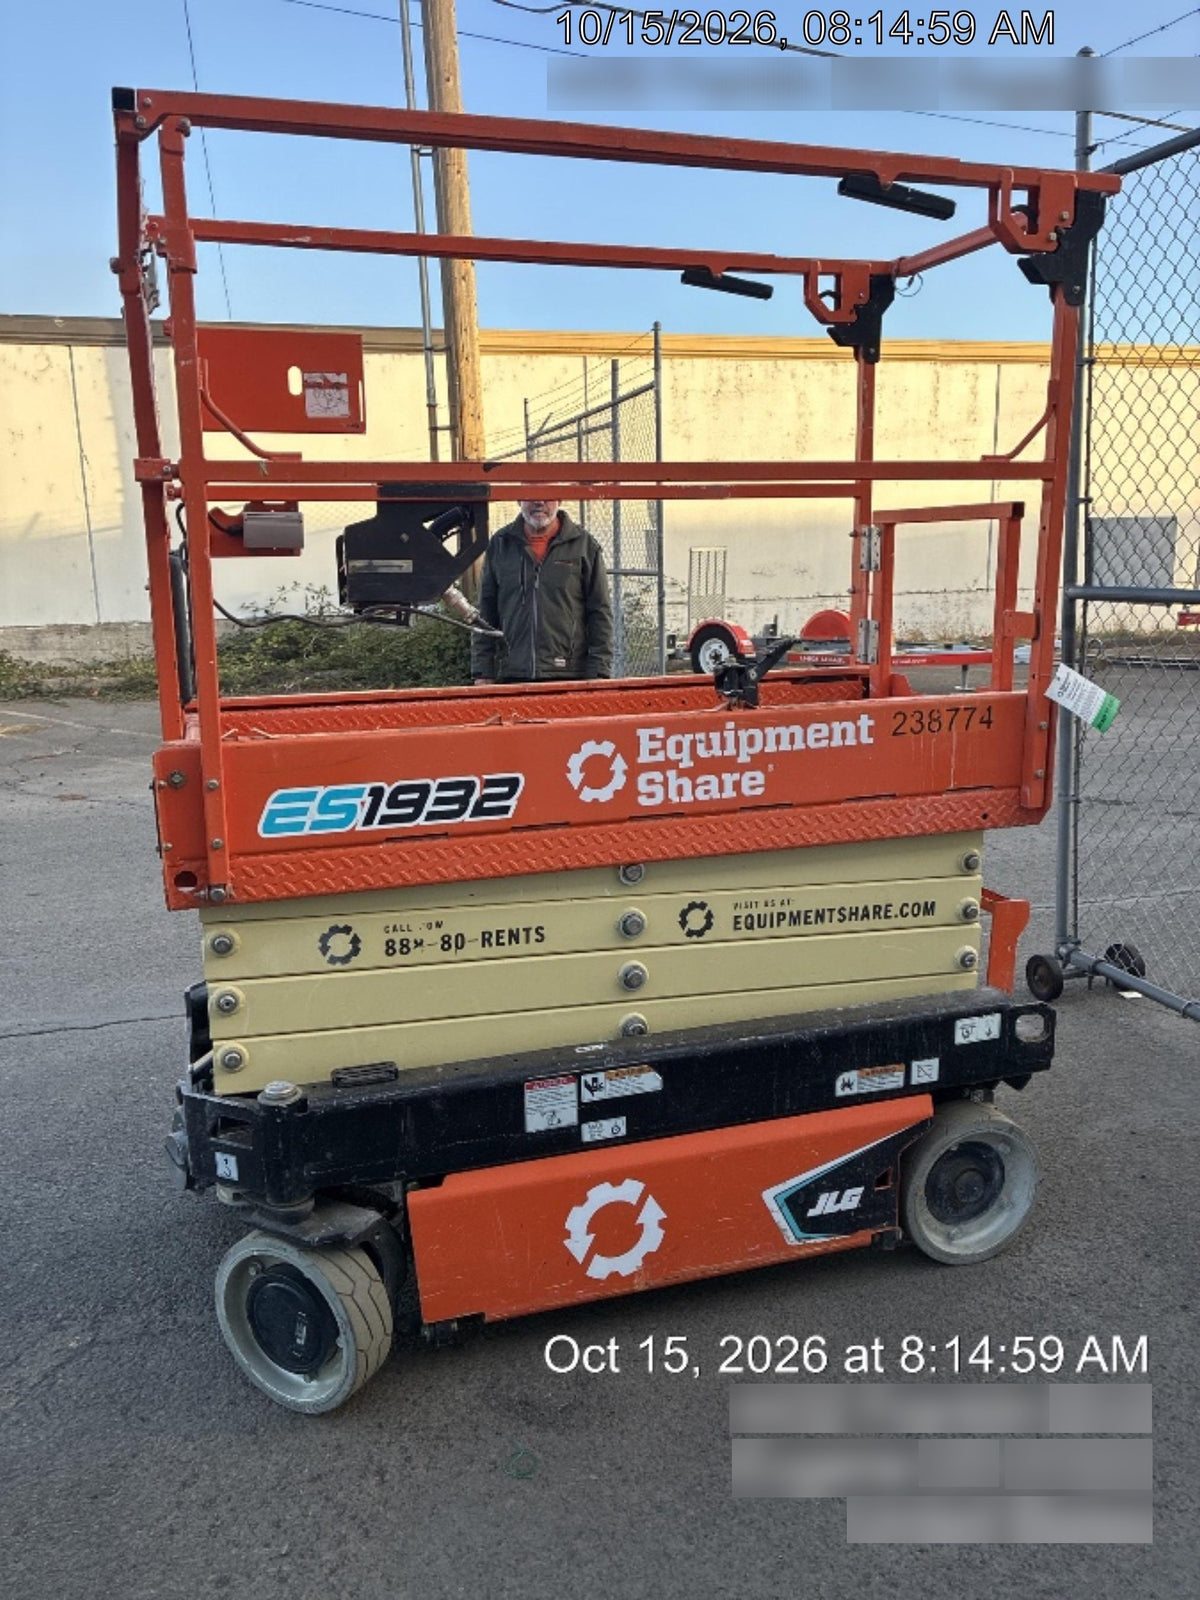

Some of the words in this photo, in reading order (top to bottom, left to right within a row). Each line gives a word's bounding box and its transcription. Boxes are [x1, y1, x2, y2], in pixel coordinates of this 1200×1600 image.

[892, 705, 994, 736] 238774
[636, 714, 874, 766] Equipment
[636, 769, 765, 806] Share
[257, 772, 525, 838] ES1932
[733, 901, 936, 931] EQUIPMENTSHARE.COM
[807, 1186, 865, 1217] JLG
